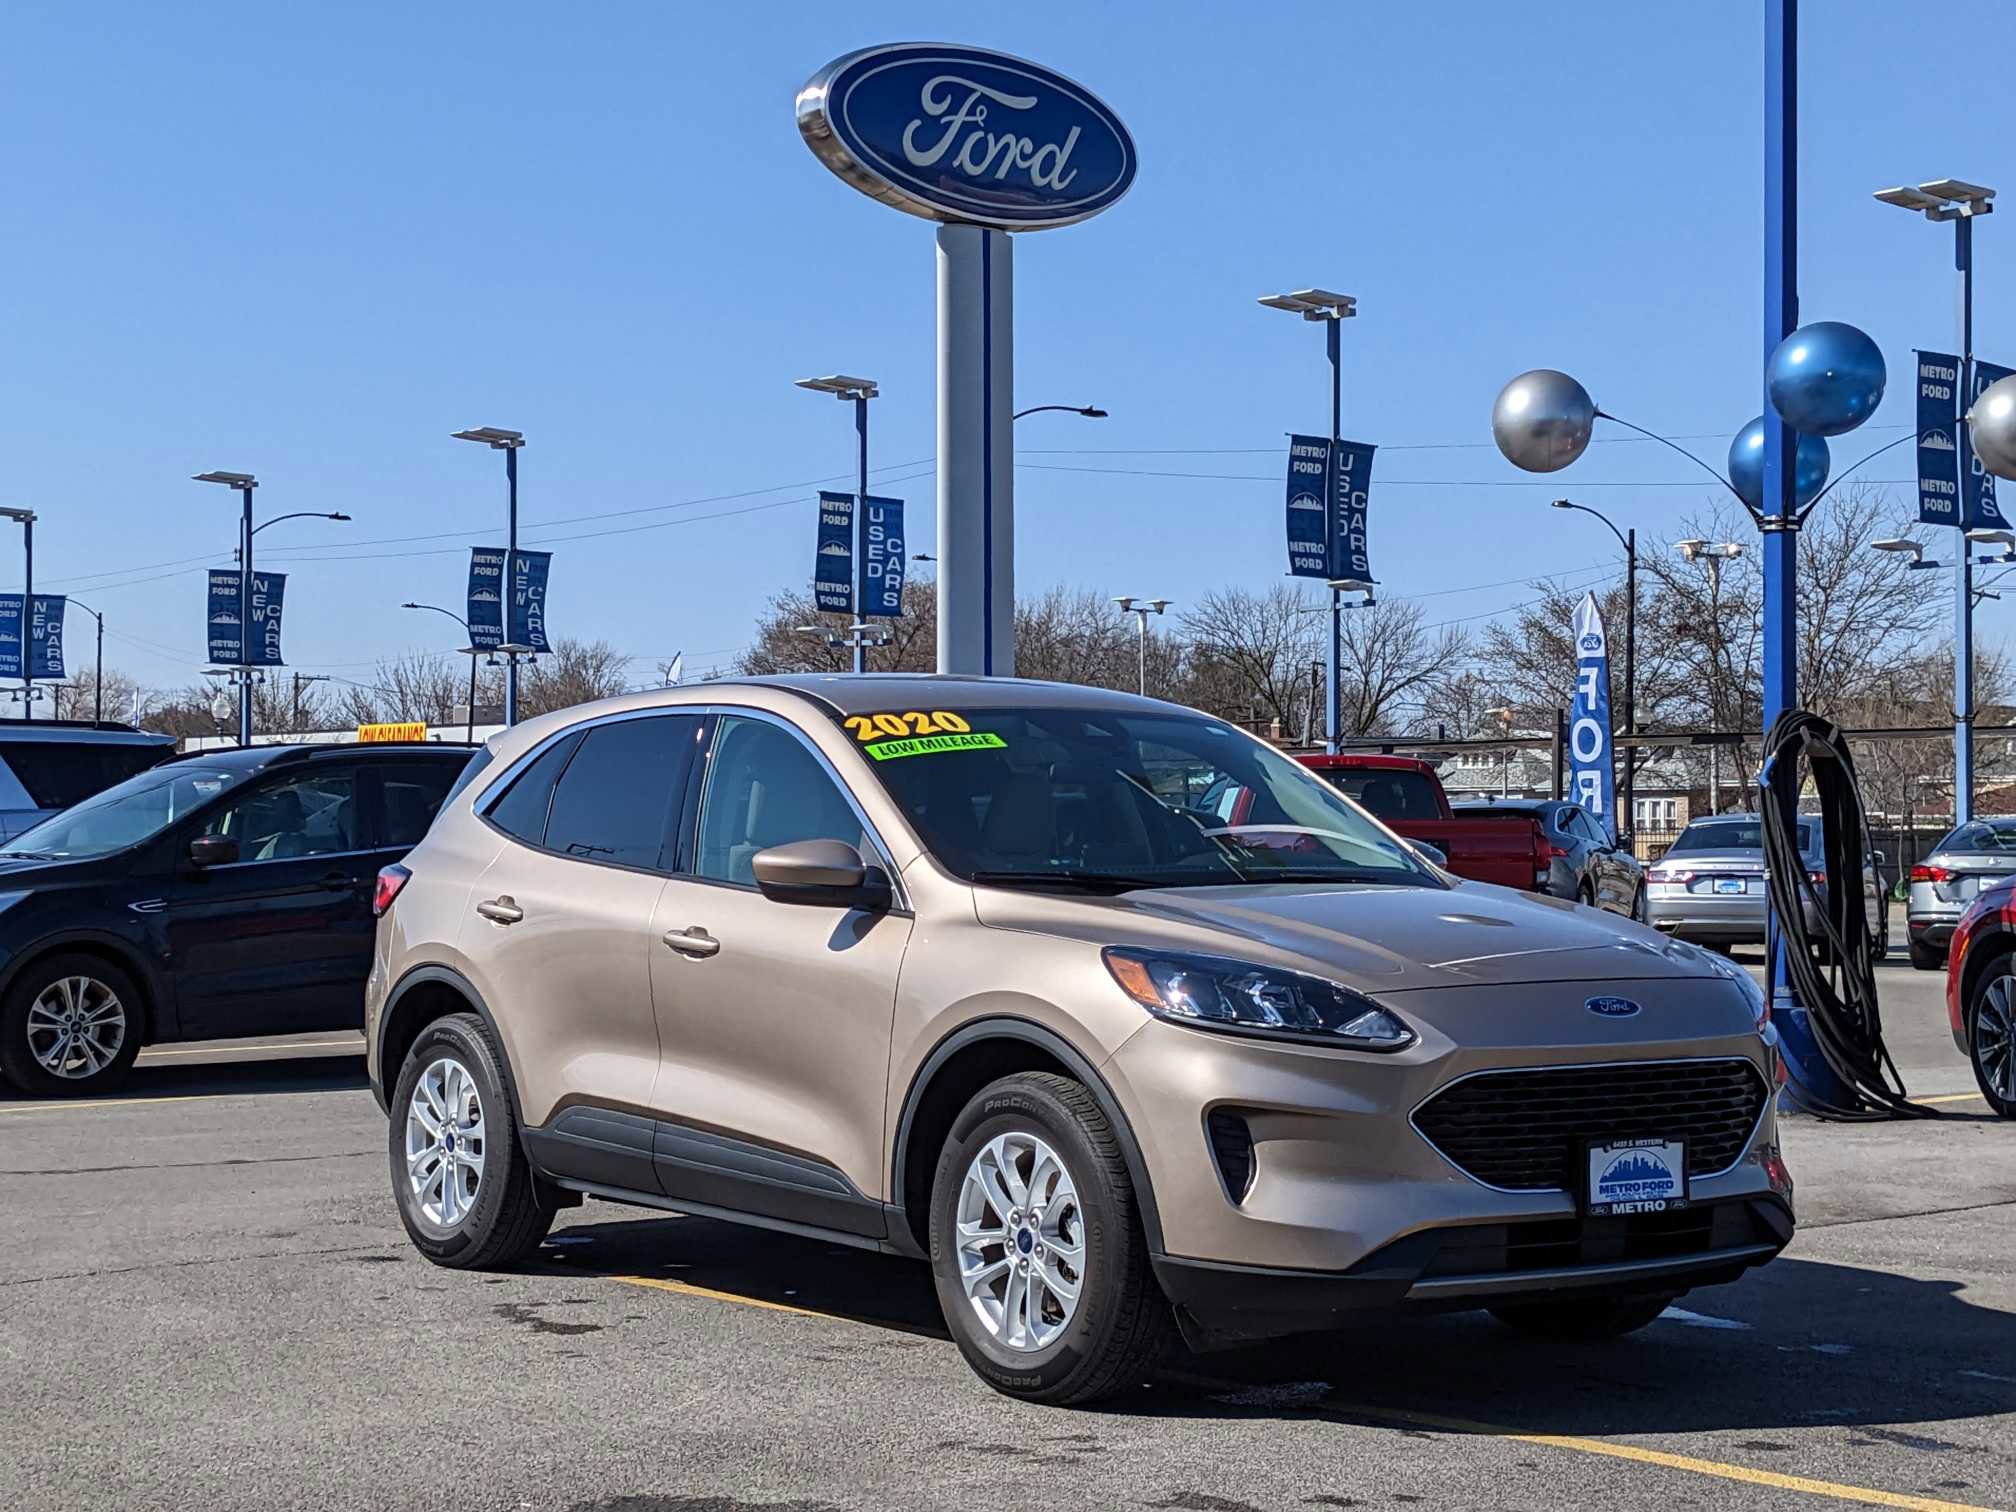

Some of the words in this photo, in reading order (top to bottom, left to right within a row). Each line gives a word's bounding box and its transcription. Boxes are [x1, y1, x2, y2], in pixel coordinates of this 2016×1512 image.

[903, 75, 1081, 191] Ford
[1920, 364, 1955, 381] METRO
[1922, 384, 1950, 400] FORD
[1292, 444, 1327, 458] METRO
[1293, 462, 1322, 474] FORD
[1920, 478, 1955, 495] METRO
[821, 500, 852, 513] METRO
[1924, 498, 1952, 513] FORD
[822, 514, 849, 526] FORD
[1350, 492, 1367, 571] CARS
[868, 507, 884, 578] USED
[1289, 541, 1325, 555] METRO
[473, 554, 503, 565] METRO
[1294, 557, 1323, 570] FORD
[474, 567, 499, 576] FORD
[883, 538, 902, 607] CARS
[210, 576, 240, 585] METRO
[816, 582, 850, 594] METRO
[212, 587, 237, 596] FORD
[252, 580, 269, 622] NEW
[820, 596, 847, 607] FORD
[32, 601, 47, 640] NEW
[528, 586, 544, 646] CARS
[265, 605, 281, 659] CARS
[470, 624, 502, 634] METRO
[46, 622, 62, 672] CARS
[210, 640, 240, 648] METRO
[213, 650, 238, 659] FORD
[844, 711, 971, 741] 2020
[877, 741, 917, 756] LOW
[920, 734, 993, 751] MILEAGE
[1600, 1000, 1631, 1012] Ford
[1599, 1182, 1640, 1195] METRO
[1642, 1180, 1674, 1191] FORD
[1612, 1200, 1666, 1215] METRO
